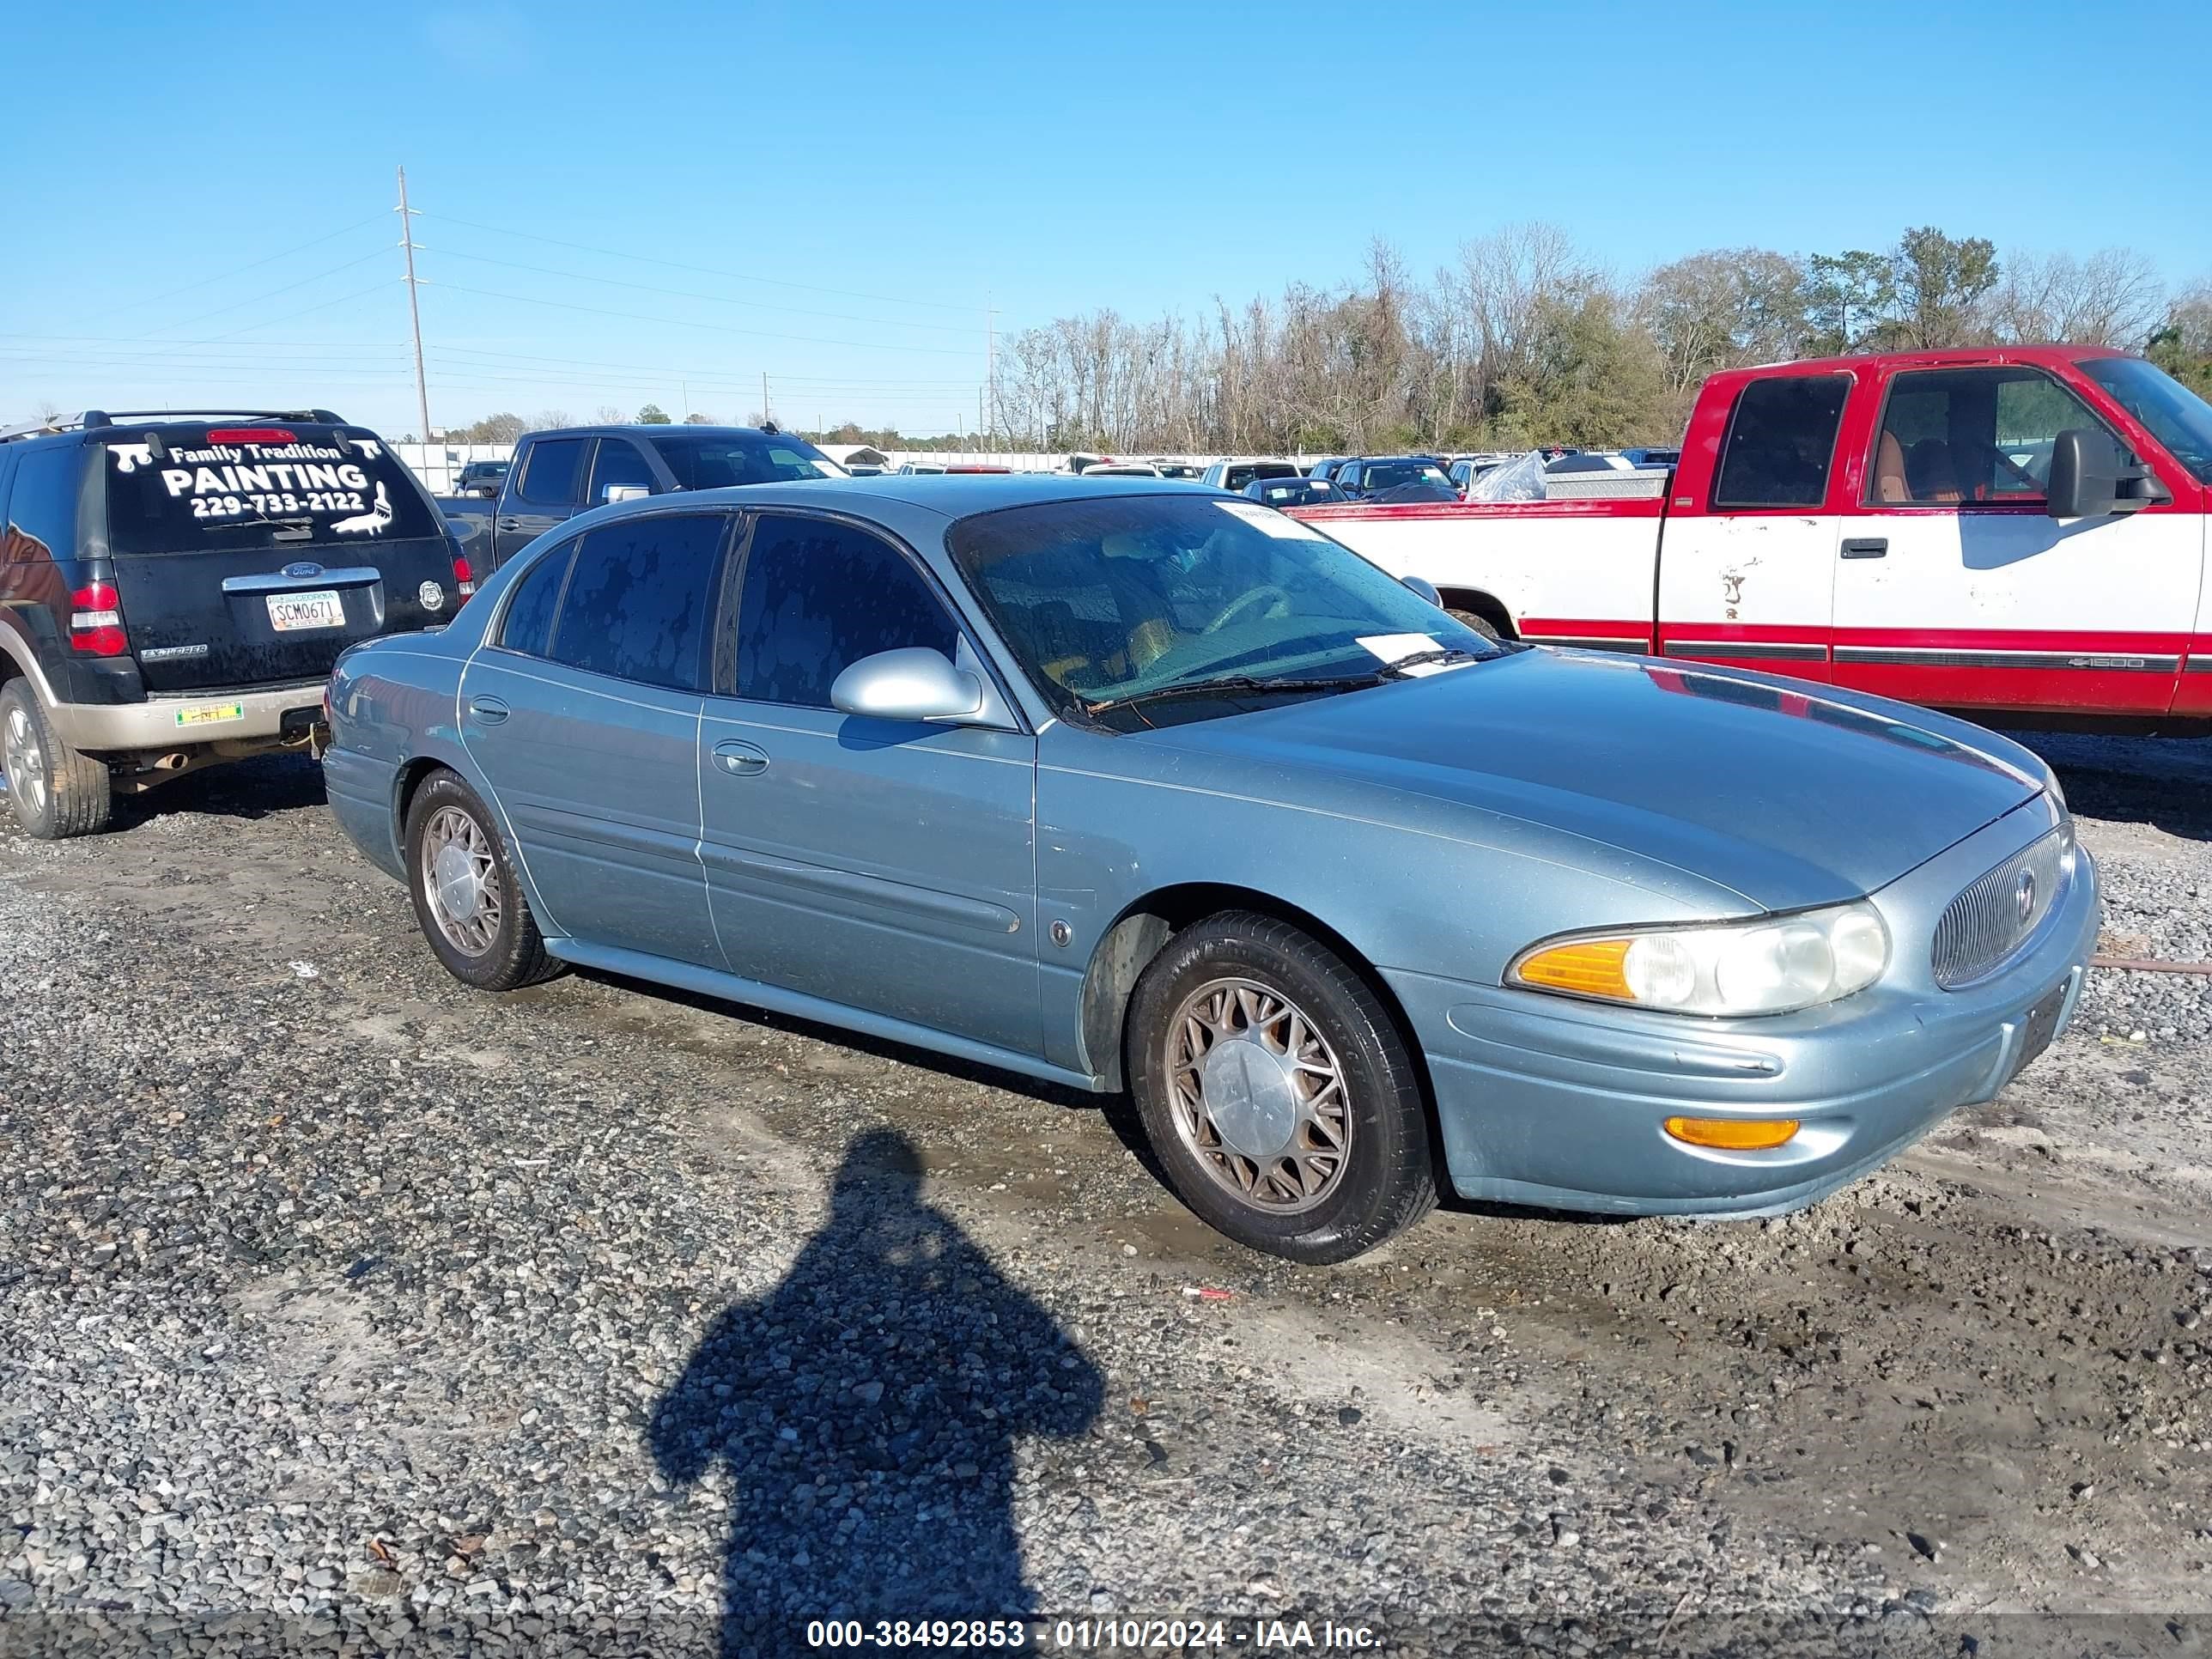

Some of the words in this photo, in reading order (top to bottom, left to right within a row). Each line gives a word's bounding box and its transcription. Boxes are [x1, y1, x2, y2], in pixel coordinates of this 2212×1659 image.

[168, 444, 242, 464] Family
[246, 443, 342, 460] Tradition
[161, 464, 368, 496] PAINTING
[190, 491, 365, 517] 229-733-2122
[292, 566, 316, 576] Ford
